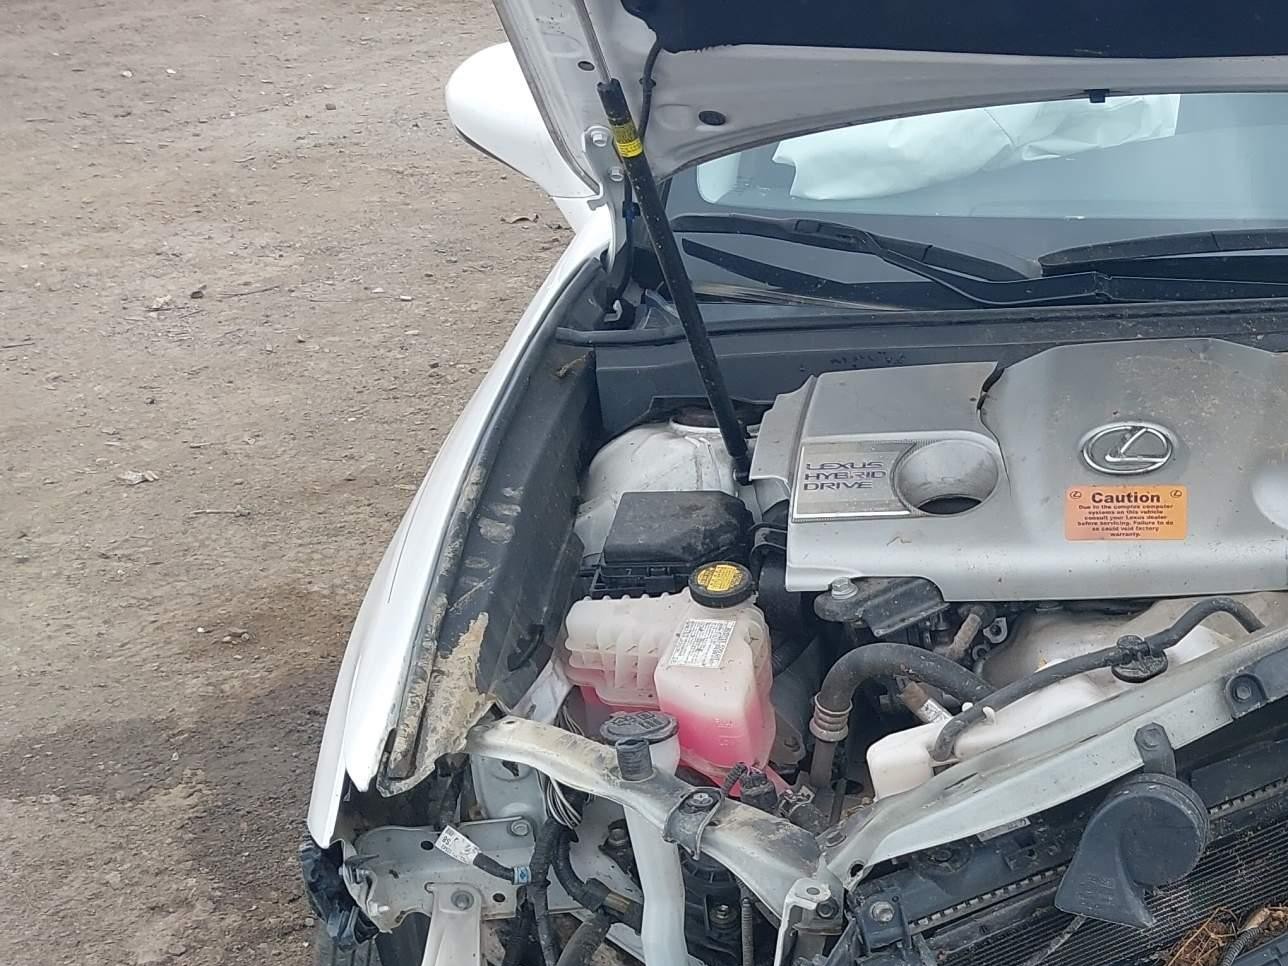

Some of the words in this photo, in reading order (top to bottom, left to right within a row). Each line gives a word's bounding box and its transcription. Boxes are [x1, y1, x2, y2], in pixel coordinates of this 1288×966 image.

[806, 462, 884, 470] LEXUS
[805, 470, 887, 480] HYBRID
[804, 481, 873, 490] DRIVE
[1091, 491, 1161, 504] Caution
